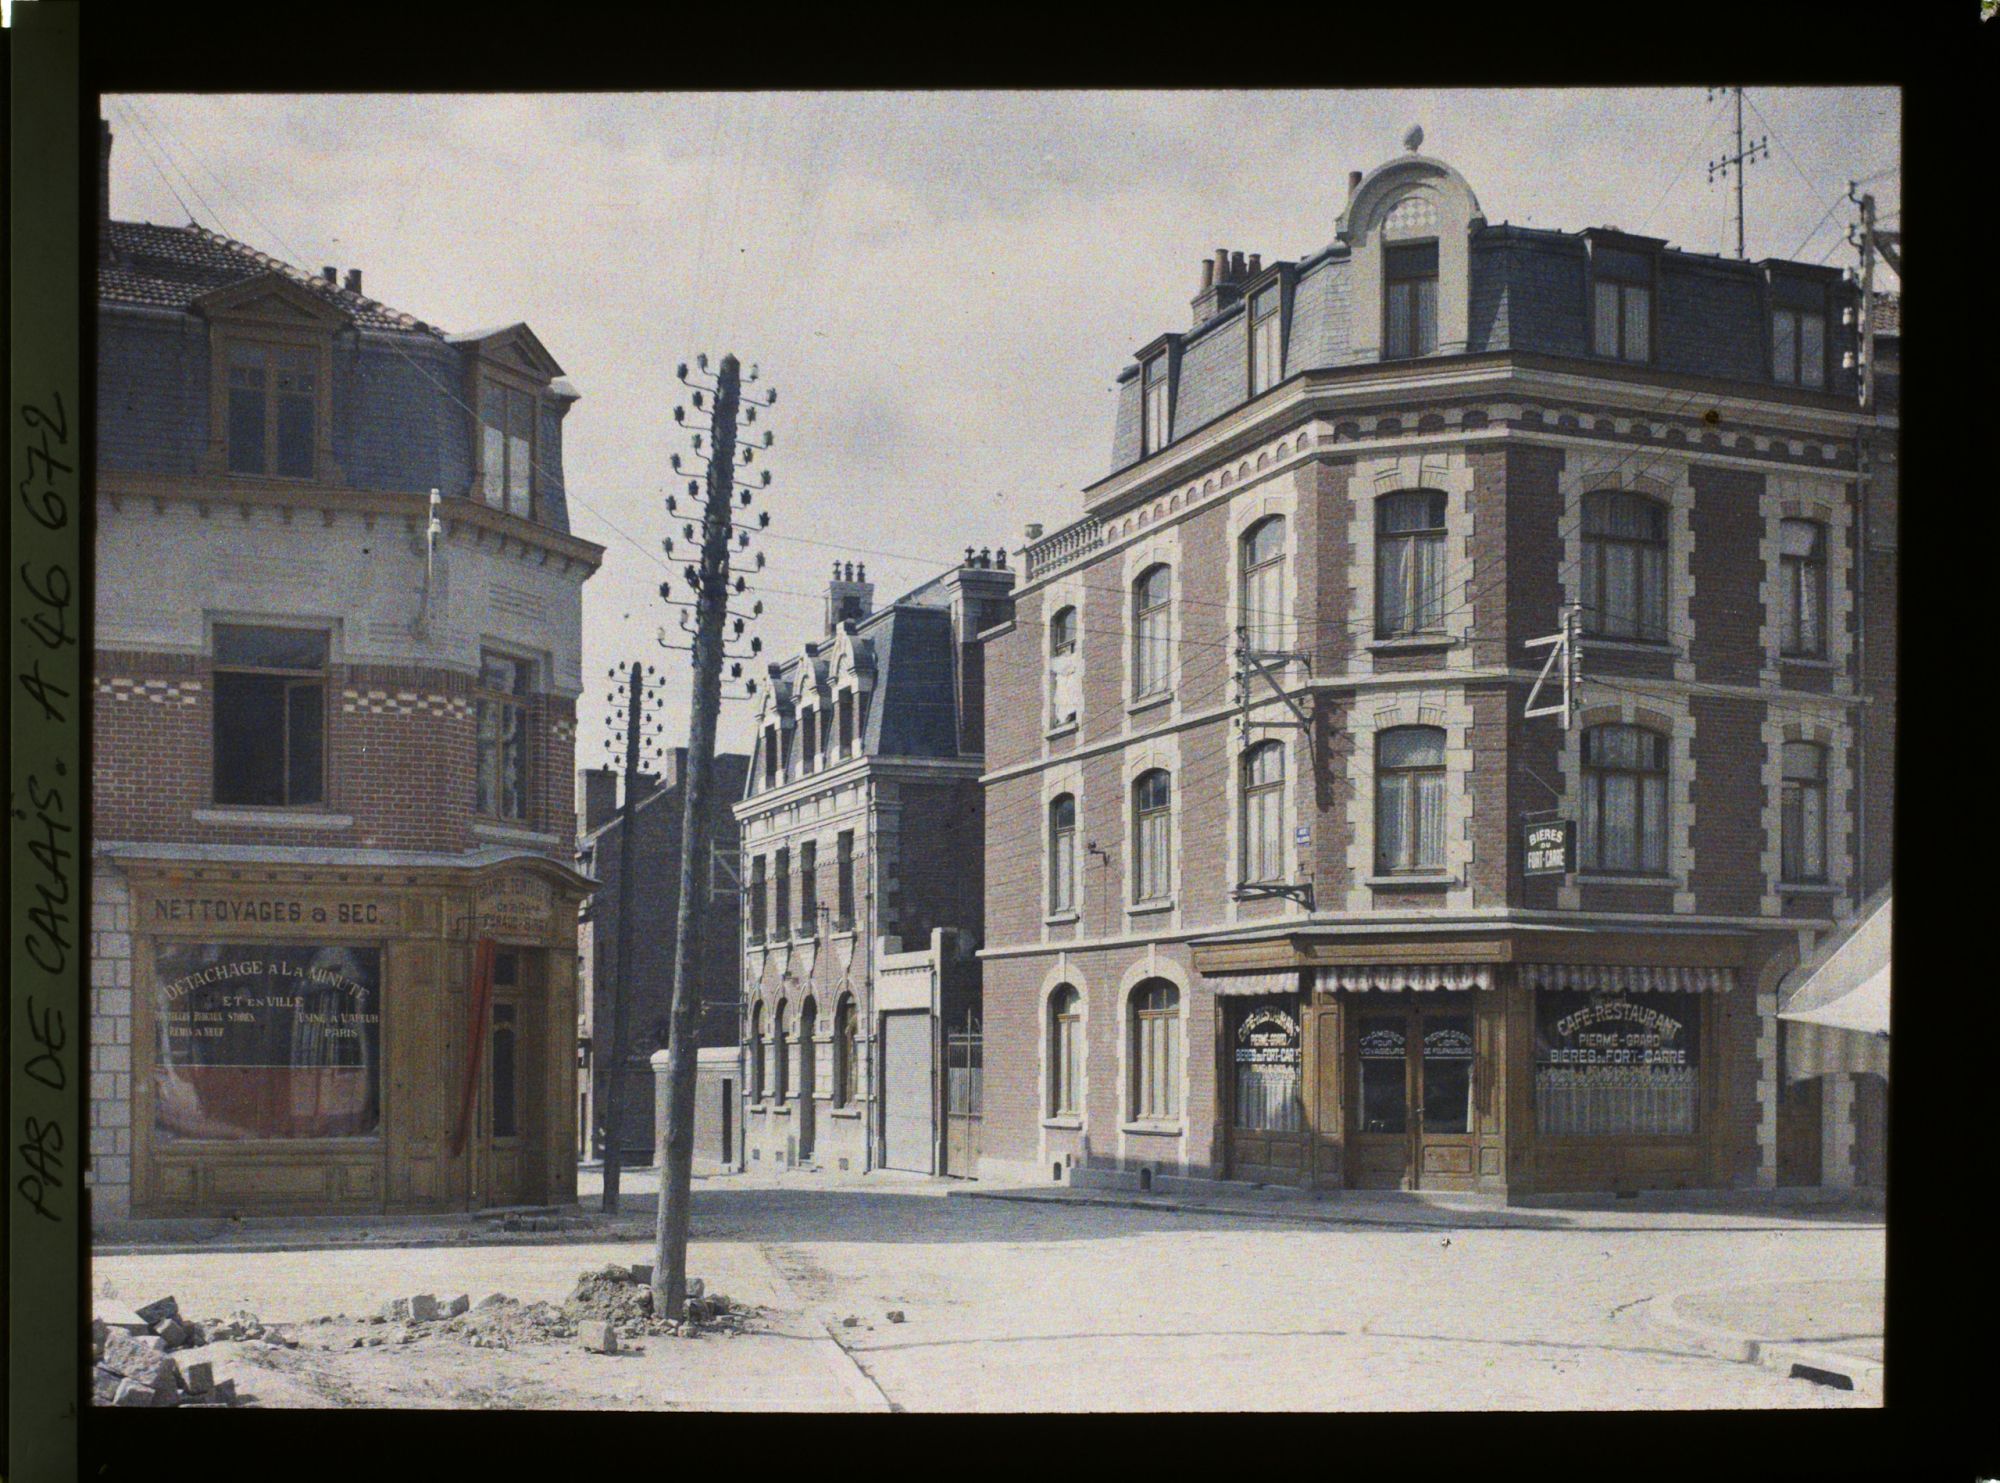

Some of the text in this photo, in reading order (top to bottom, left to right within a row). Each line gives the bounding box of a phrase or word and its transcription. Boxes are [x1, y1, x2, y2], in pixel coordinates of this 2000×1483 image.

[19, 390, 73, 530] 672
[19, 658, 70, 722] A
[154, 898, 300, 923] NETTOYAGES
[308, 966, 371, 1002] MINUTE
[222, 996, 242, 1007] ET
[266, 996, 304, 1008] VILLE
[324, 1027, 358, 1038] PARIS
[341, 1012, 379, 1024] VAPEUR
[24, 995, 66, 1090] DE
[1372, 1039, 1393, 1047] POUR
[17, 1115, 64, 1222] PAS
